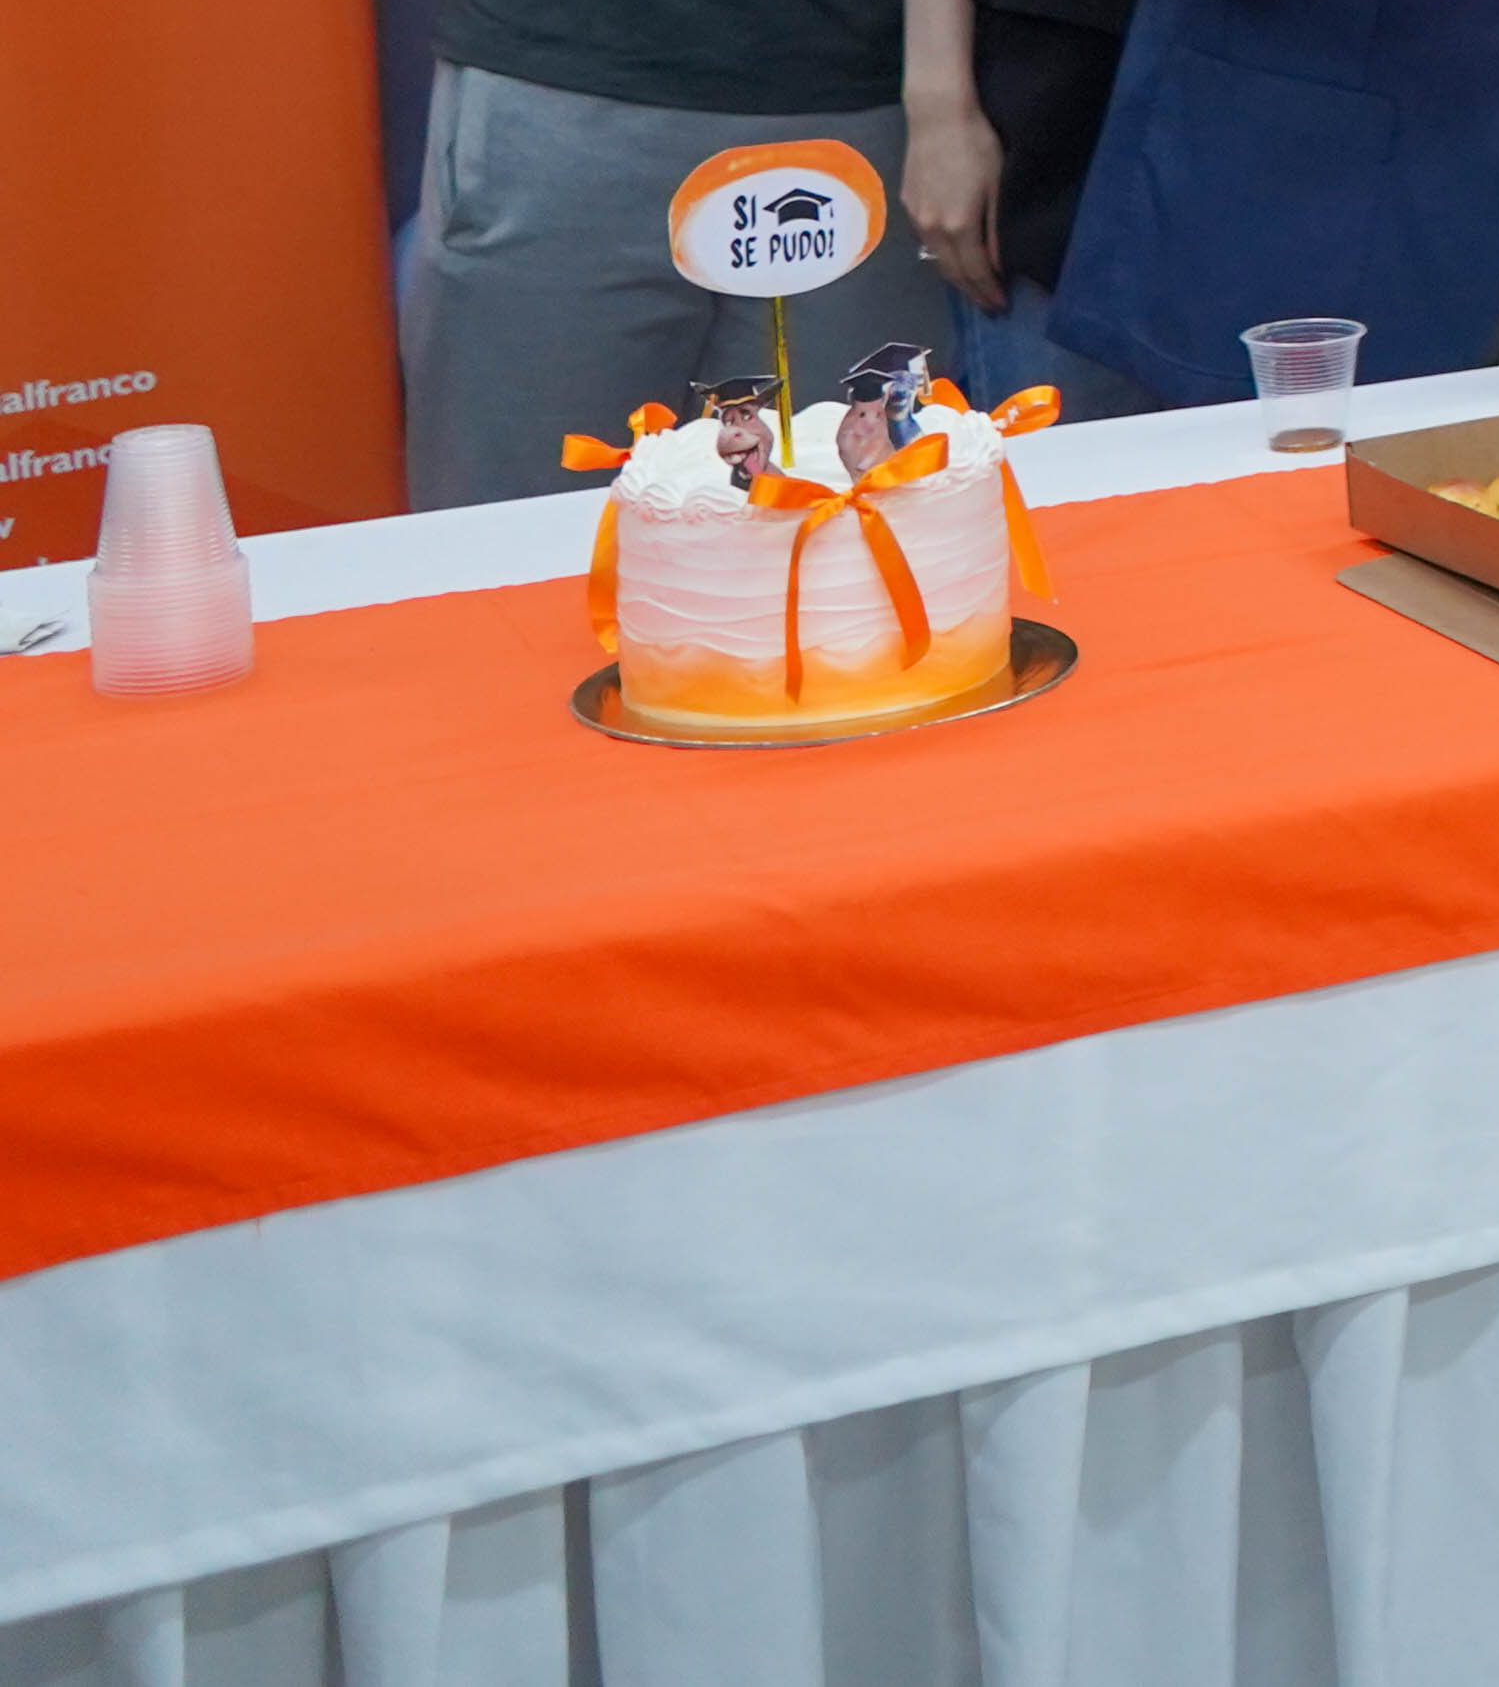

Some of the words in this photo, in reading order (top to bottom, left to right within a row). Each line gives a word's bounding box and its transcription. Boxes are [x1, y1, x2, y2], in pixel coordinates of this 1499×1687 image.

[733, 194, 757, 231] SI
[731, 236, 757, 268] SE
[769, 228, 834, 264] PUDO!
